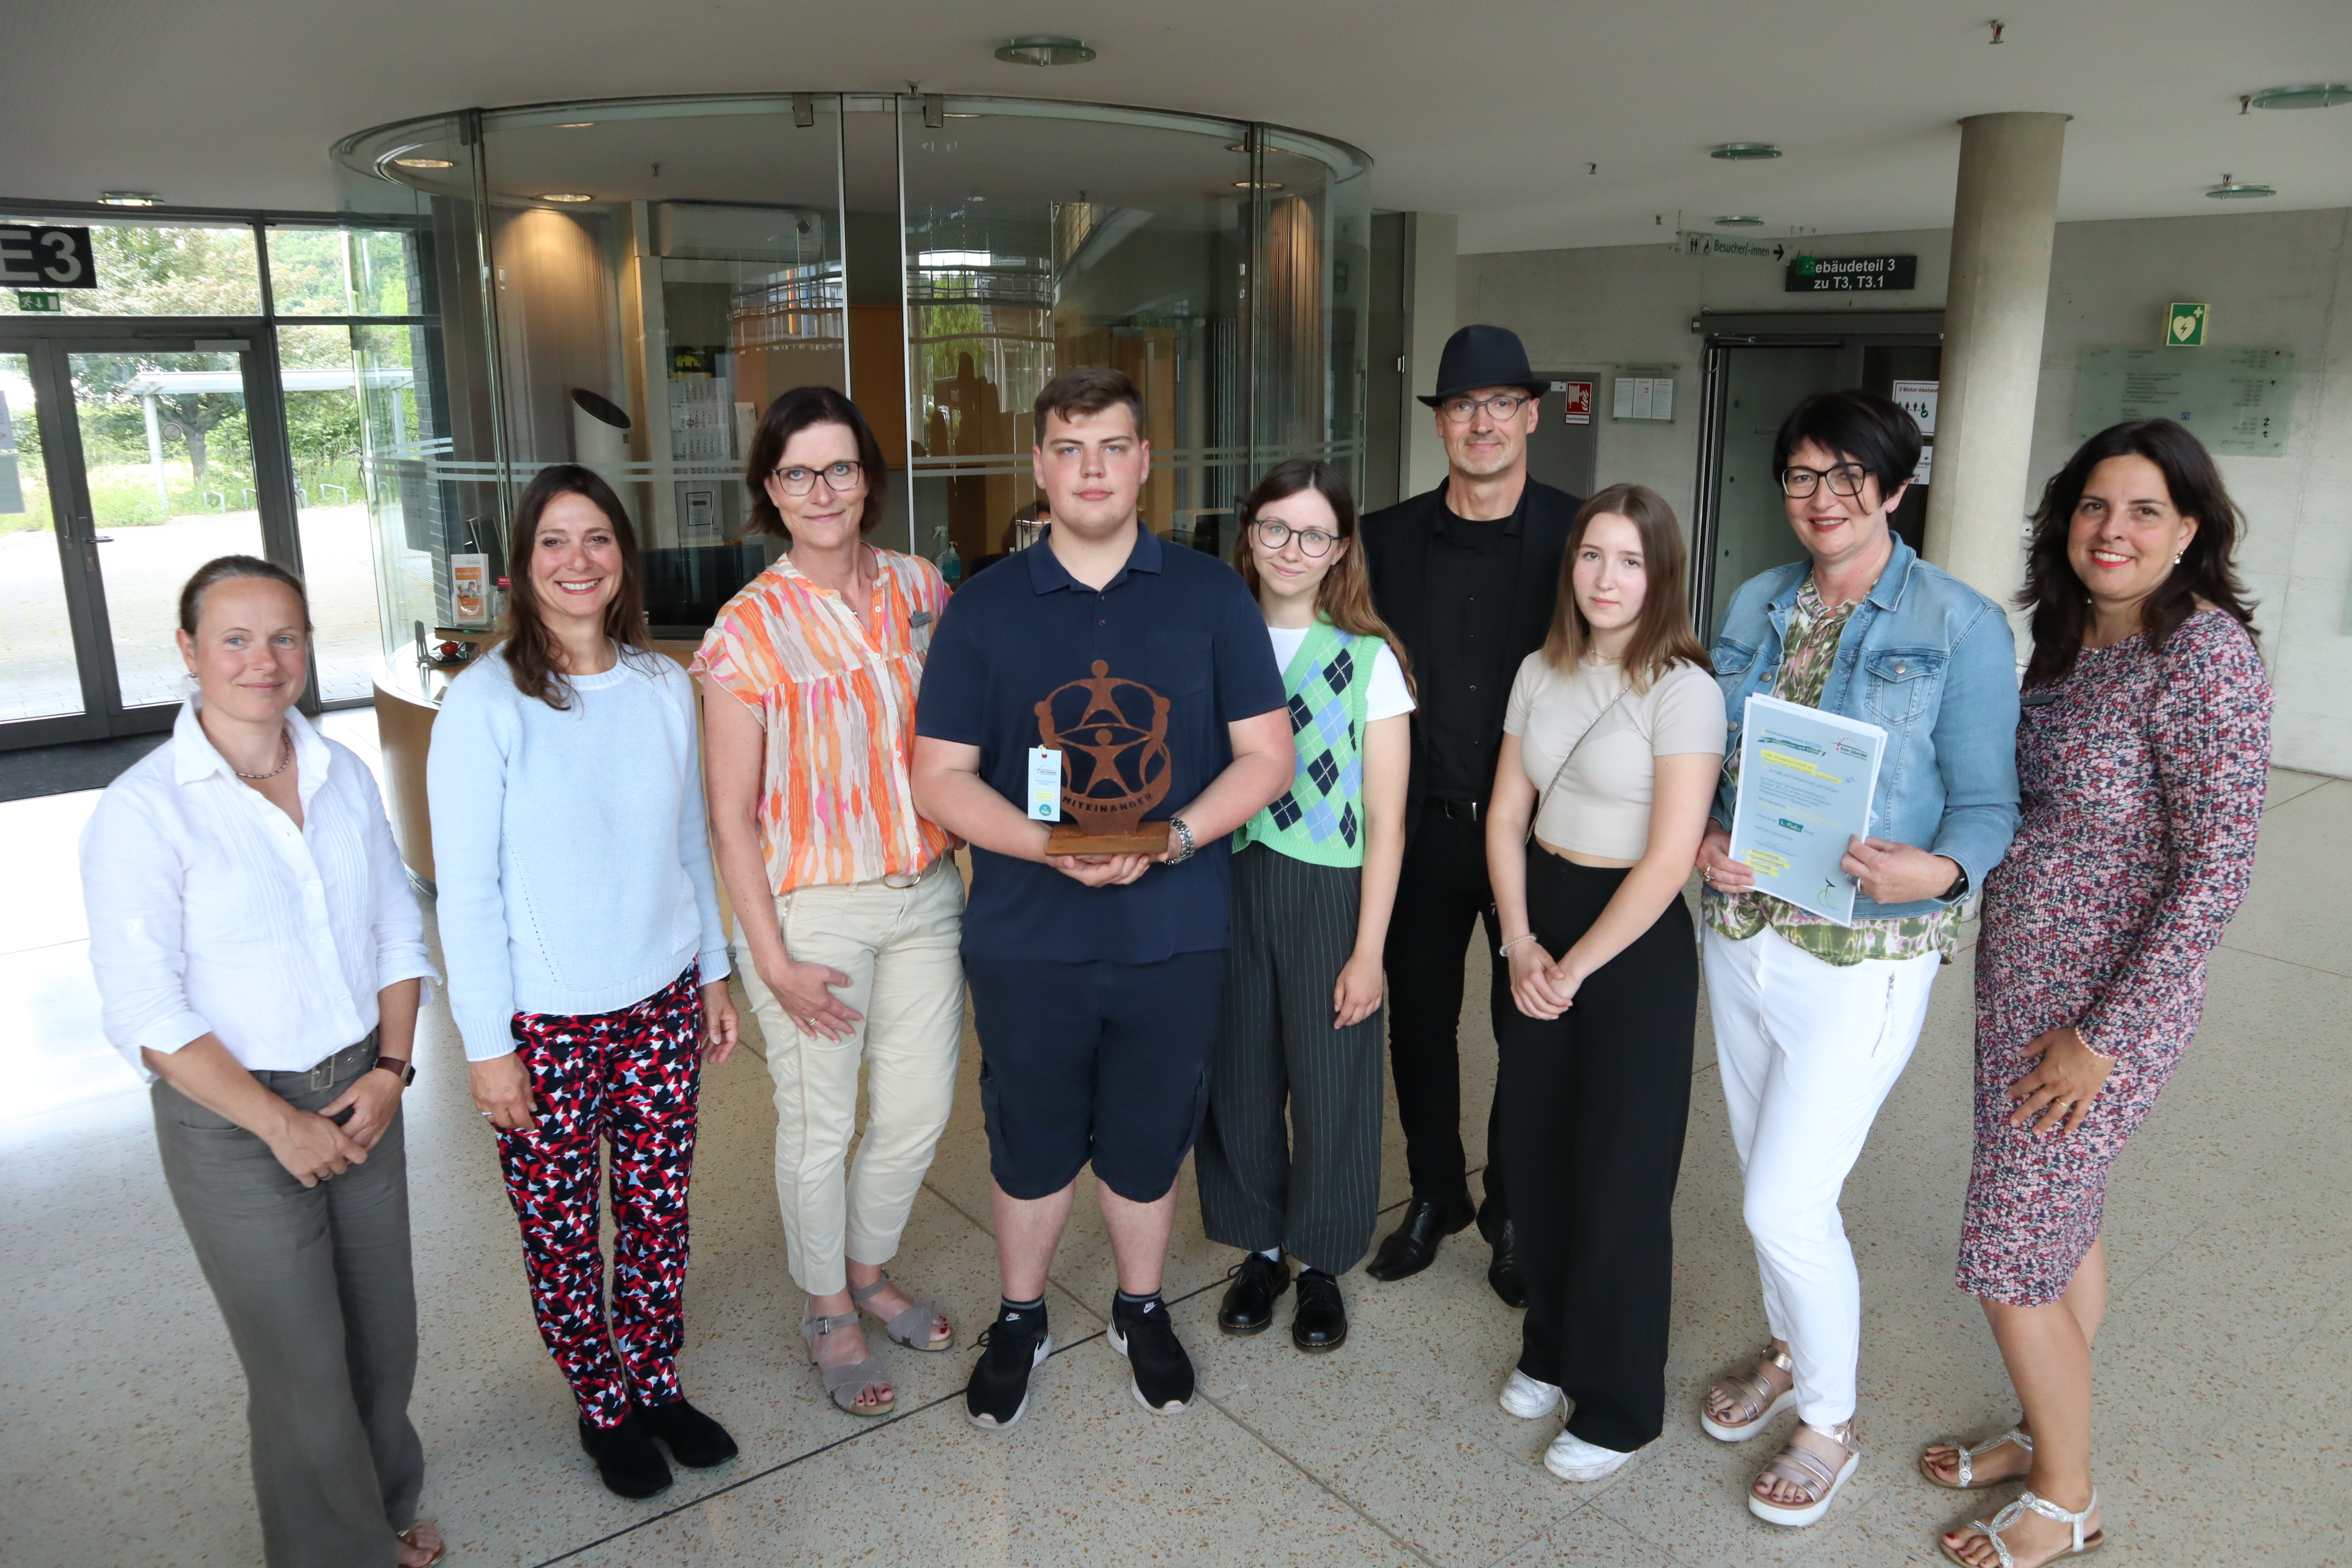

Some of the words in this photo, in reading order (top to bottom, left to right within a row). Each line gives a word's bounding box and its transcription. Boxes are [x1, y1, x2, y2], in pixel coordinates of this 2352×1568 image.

[1714, 239, 1770, 256] Besucher/-innen
[0, 230, 81, 282] E3
[1815, 259, 1883, 273] ebäudeteil
[1887, 259, 1895, 272] 3
[1814, 279, 1829, 289] zu
[1833, 276, 1853, 290] T3,
[1857, 275, 1884, 288] T3.1
[1062, 793, 1153, 813] MITEINANDER
[1786, 822, 1802, 831] Platz
